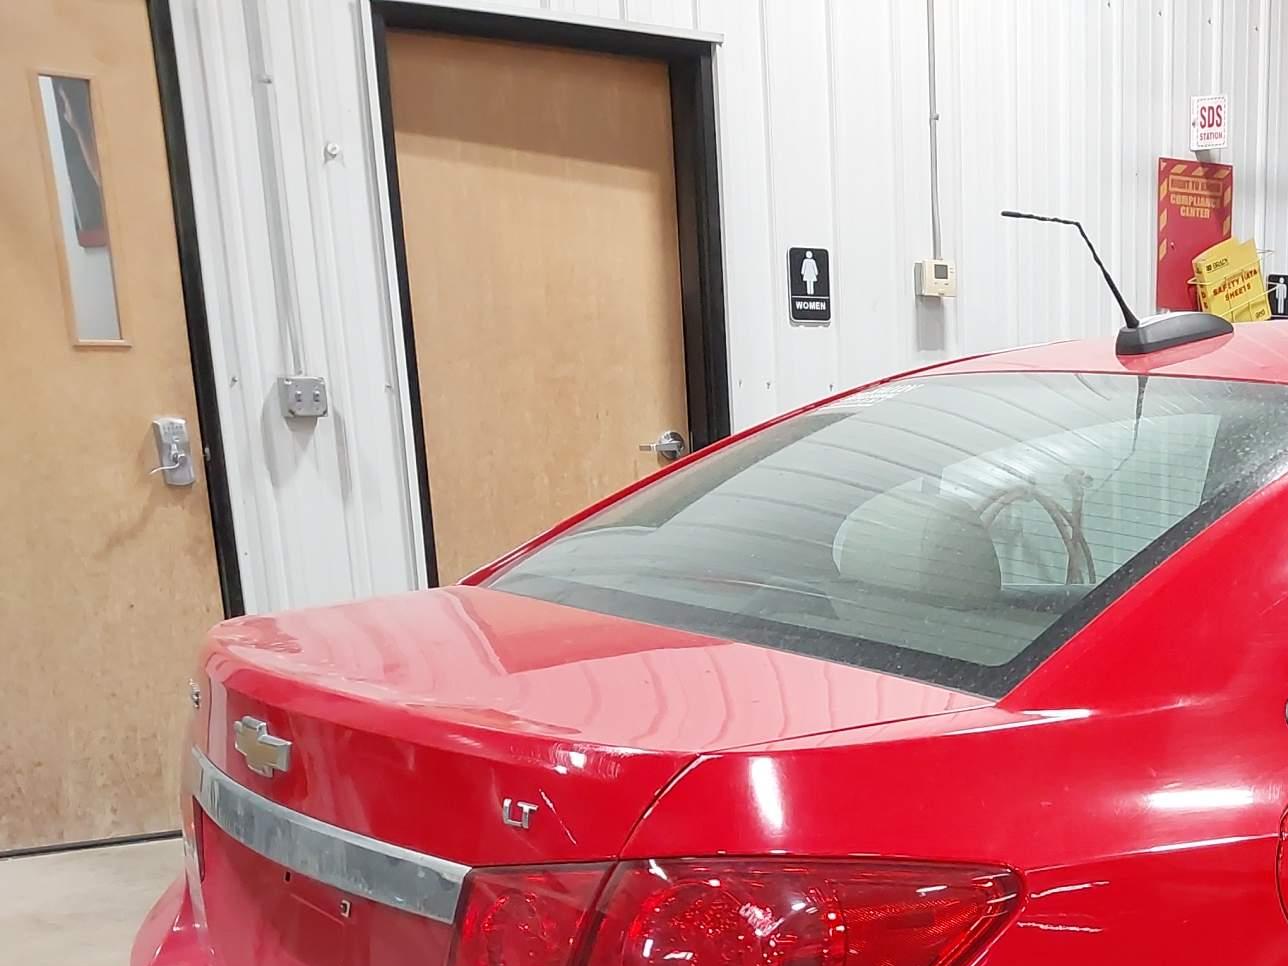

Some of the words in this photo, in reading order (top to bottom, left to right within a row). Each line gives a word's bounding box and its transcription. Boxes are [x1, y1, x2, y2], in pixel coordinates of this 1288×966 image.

[1200, 104, 1223, 129] SDS
[1199, 131, 1223, 141] STATION
[1180, 206, 1210, 219] CENTER
[1213, 278, 1240, 296] SAFETY
[1225, 283, 1251, 302] SHEETS
[795, 301, 827, 310] WOMEN
[503, 798, 539, 829] LT
